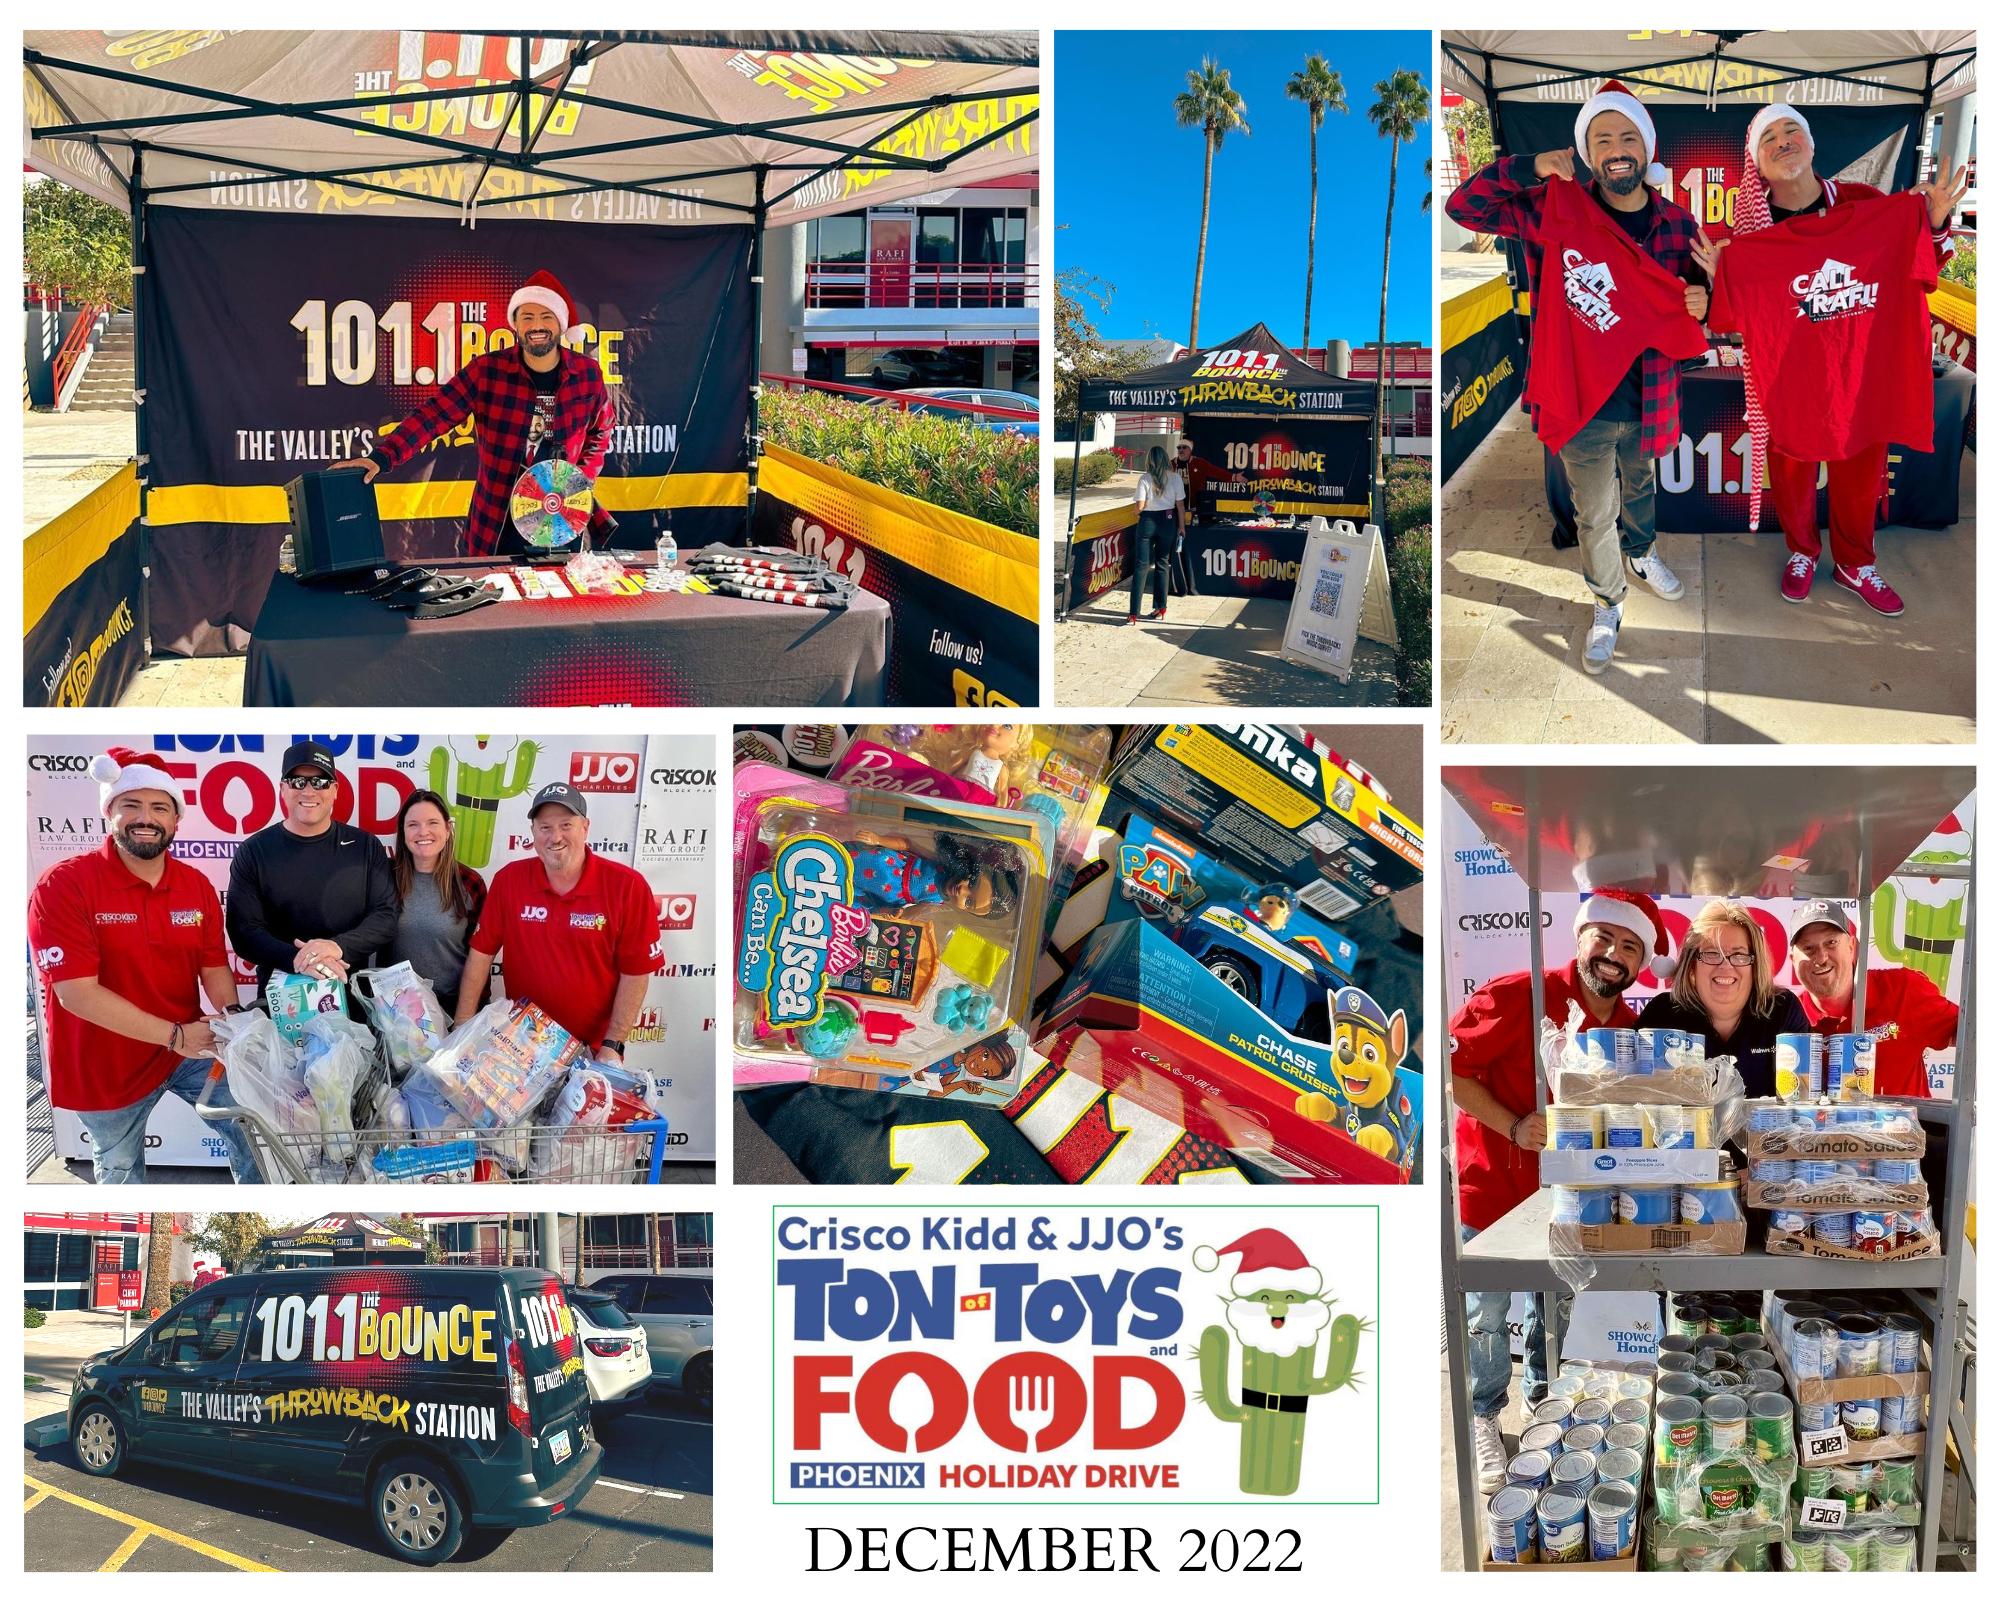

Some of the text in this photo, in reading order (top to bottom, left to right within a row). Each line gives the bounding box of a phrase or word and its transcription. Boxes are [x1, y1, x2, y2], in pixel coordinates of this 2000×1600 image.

[1705, 167, 1726, 184] THE
[876, 249, 905, 258] RAFI
[1561, 248, 1613, 303] CALL
[1792, 264, 1859, 296] CALL
[460, 302, 487, 322] THE
[1811, 282, 1879, 316] RAFI!
[1813, 309, 1868, 323] ACCIDENT ATTORNEY
[289, 298, 458, 387] 101.1
[461, 322, 625, 386] BOCE
[1201, 348, 1282, 369] 101.1
[1190, 366, 1287, 381] BOUNCE
[1108, 380, 1344, 410] THE VALLEY'S THROWBACK STATION
[236, 430, 275, 461] THE
[281, 425, 374, 462] VALLEY'S
[1223, 442, 1273, 471] 101.1
[1272, 442, 1283, 451] THE
[1272, 450, 1327, 473] BOUNCE
[1658, 431, 1763, 495] 01.1
[1206, 476, 1345, 498] THE VALLEY'S THROWBACK STATION
[1090, 532, 1122, 573] 101.1
[1201, 548, 1250, 579] 101.1
[1251, 550, 1261, 559] THE
[1087, 561, 1123, 594] BOUNCE
[929, 627, 984, 666] Follow us!
[396, 759, 416, 769] and
[572, 753, 635, 784] JJO
[576, 784, 629, 792] CHARITIES
[37, 815, 108, 834] RAFI
[643, 828, 709, 845] RAFI
[1367, 821, 1405, 852] MIGHTY
[38, 834, 107, 843] LAW GROU
[641, 845, 707, 854] LAW GROUP
[1154, 831, 1193, 857] nickelodeon
[1120, 844, 1207, 911] PAW
[1464, 859, 1516, 877] Honda
[520, 905, 548, 920] JJO
[751, 883, 774, 931] Can
[1128, 885, 1176, 918] PATROL
[569, 919, 595, 927] FOOD
[776, 846, 843, 1017] Chelsea
[829, 901, 866, 976] Barbie
[1153, 947, 1193, 976] WARNING:
[1139, 972, 1187, 1004] ATTENTION
[269, 992, 281, 1012] 600
[490, 1026, 525, 1057] Walmart
[1228, 1032, 1279, 1068] PATROL
[1256, 1033, 1318, 1076] CHASE
[1855, 1040, 1870, 1048] Great
[295, 1235, 337, 1247] THROWBACK
[1862, 1229, 1880, 1237] Sauce
[119, 1299, 139, 1308] PARKING
[122, 1288, 137, 1298] CLIENT
[360, 1291, 381, 1308] THE
[256, 1293, 359, 1363] 101.1
[358, 1303, 498, 1363] BOUNCE
[520, 1293, 564, 1349] 101.1
[533, 1374, 547, 1394] THE
[181, 1385, 497, 1441] THE VALLEY'S THROWBACK STATION
[1712, 1493, 1720, 1501] Del
